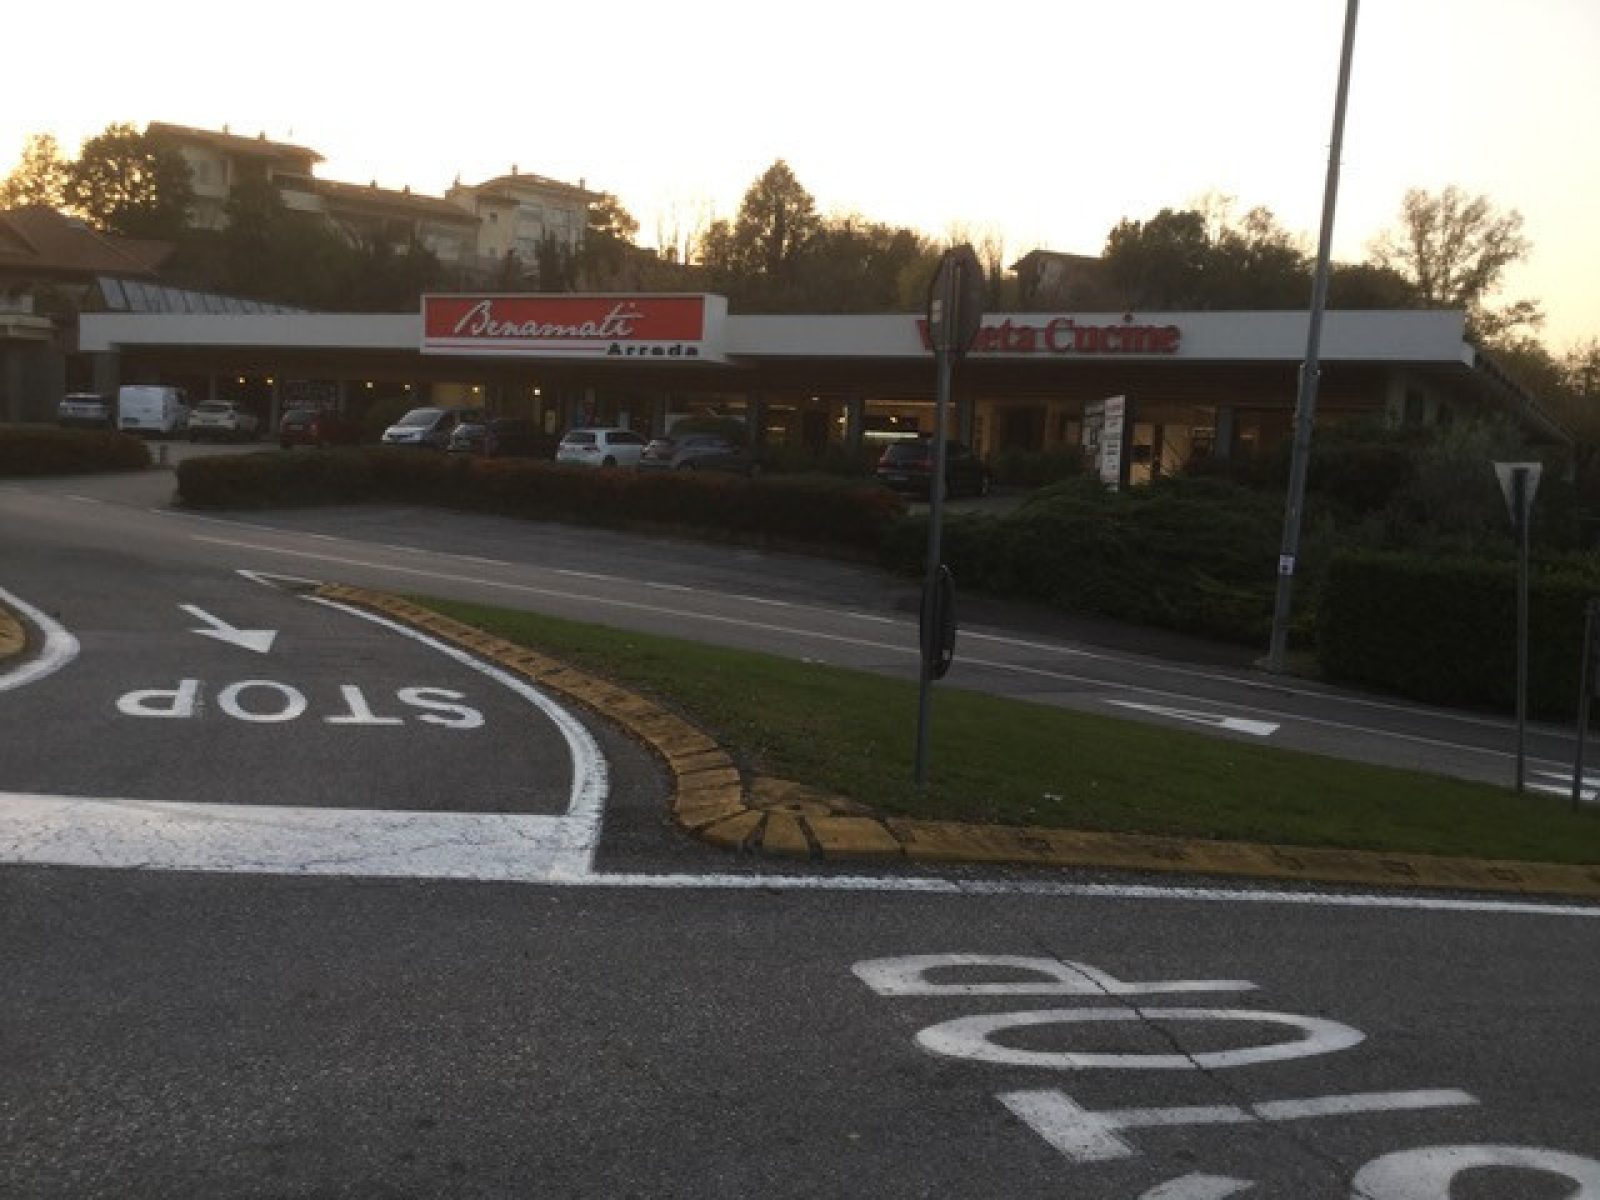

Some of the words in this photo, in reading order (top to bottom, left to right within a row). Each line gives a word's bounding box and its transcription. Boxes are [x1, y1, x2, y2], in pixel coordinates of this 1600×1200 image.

[452, 299, 645, 336] Benamati
[1044, 314, 1181, 352] Cucine
[115, 679, 485, 729] STOP
